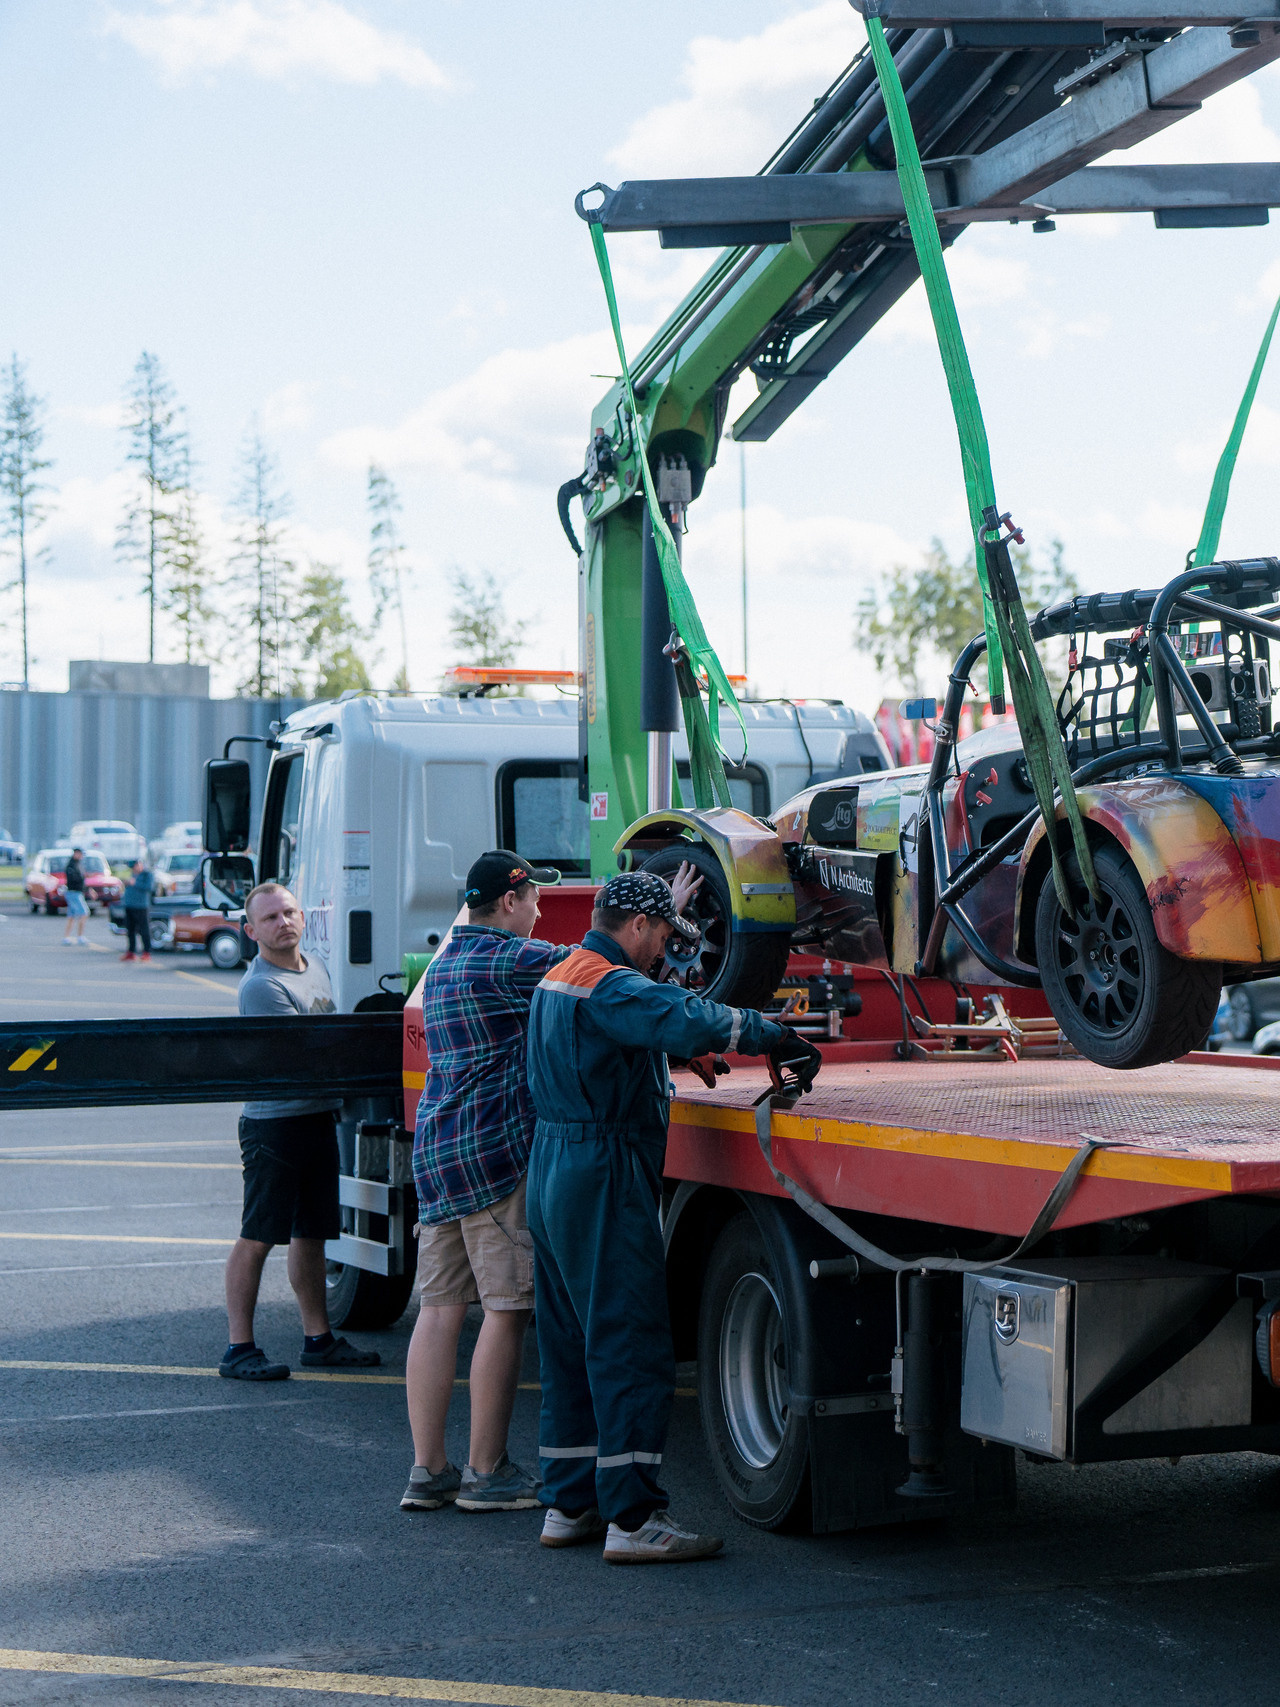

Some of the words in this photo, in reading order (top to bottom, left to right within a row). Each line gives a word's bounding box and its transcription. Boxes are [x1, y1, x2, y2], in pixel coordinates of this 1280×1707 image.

[587, 621, 595, 717] PALFINGER
[830, 865, 838, 886] N
[838, 867, 874, 896] Architects
